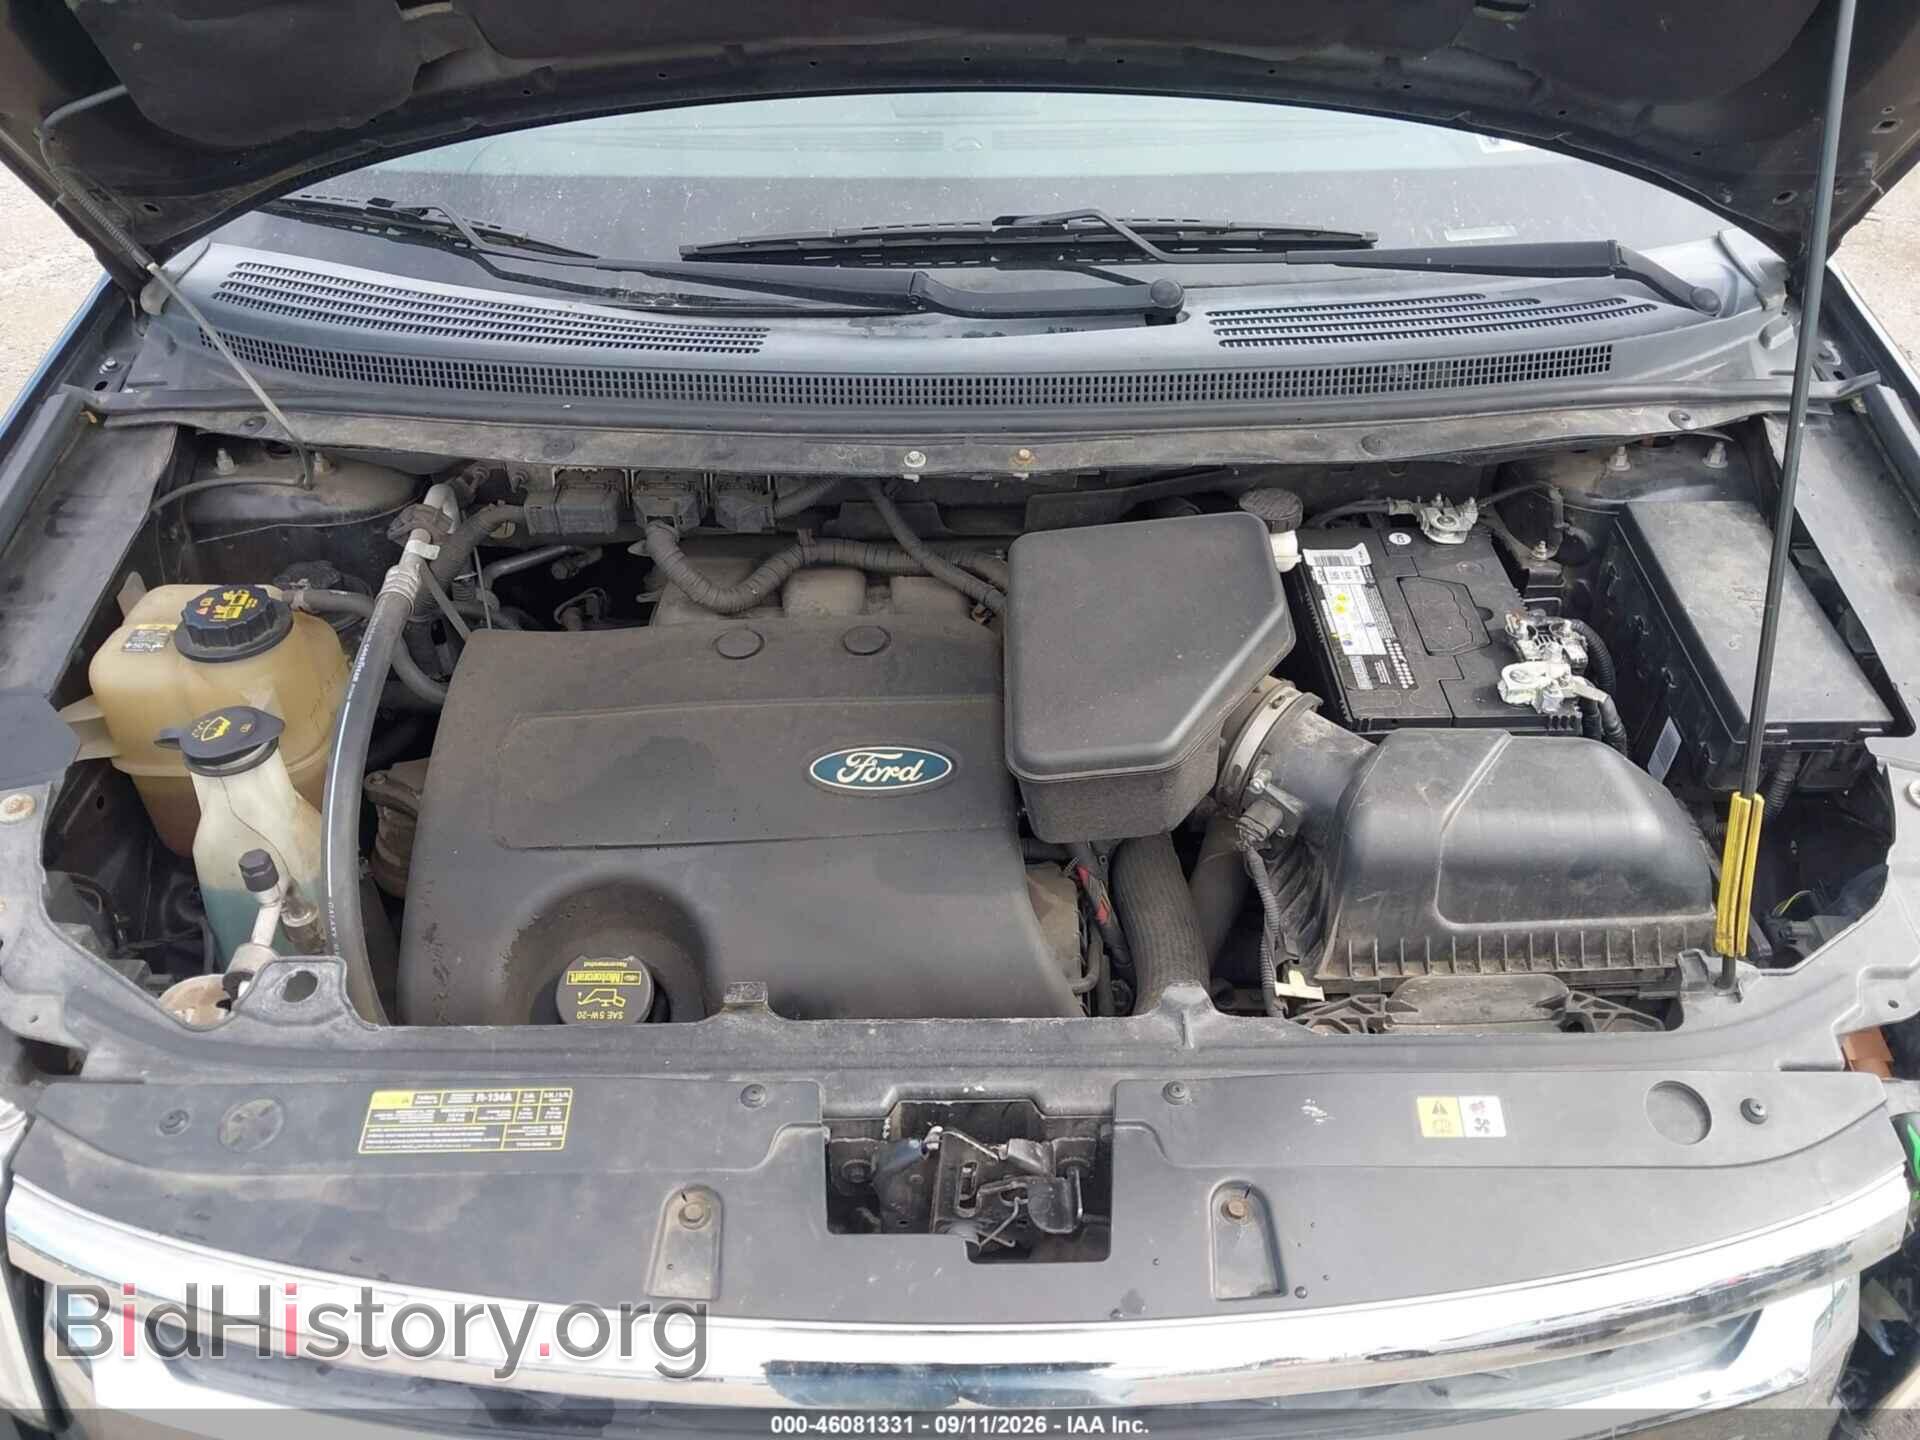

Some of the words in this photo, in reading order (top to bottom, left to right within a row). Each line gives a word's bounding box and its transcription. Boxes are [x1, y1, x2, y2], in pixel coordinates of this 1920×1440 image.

[836, 752, 926, 783] Ford
[607, 1010, 624, 1020] SAE
[476, 1093, 513, 1103] R-134A
